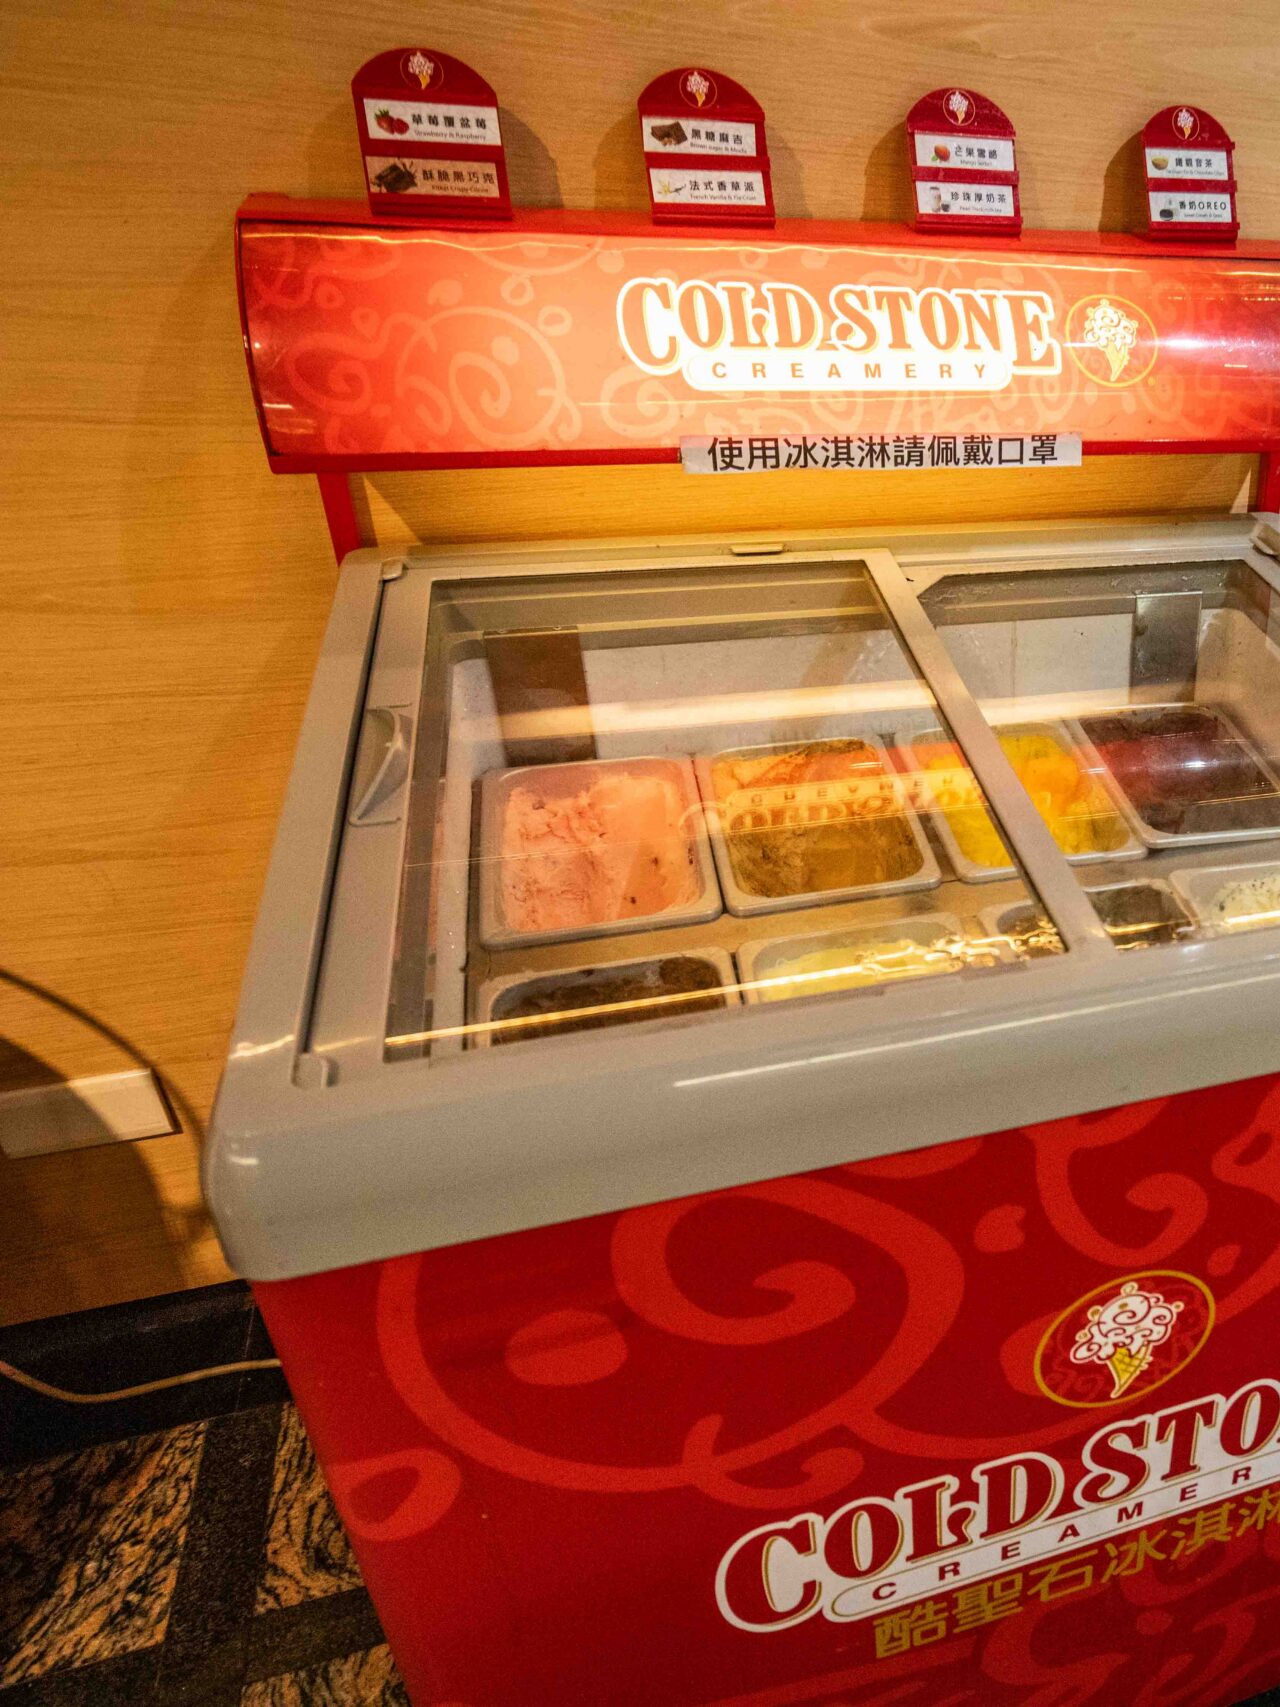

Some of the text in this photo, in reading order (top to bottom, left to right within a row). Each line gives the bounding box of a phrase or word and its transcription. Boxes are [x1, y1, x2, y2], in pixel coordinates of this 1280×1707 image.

[620, 279, 1059, 373] COLD STONE
[711, 361, 986, 380] CREAMERY
[707, 433, 1060, 473] 使用冰淇淋請佩戴口罩
[721, 1455, 1059, 1628] COLD
